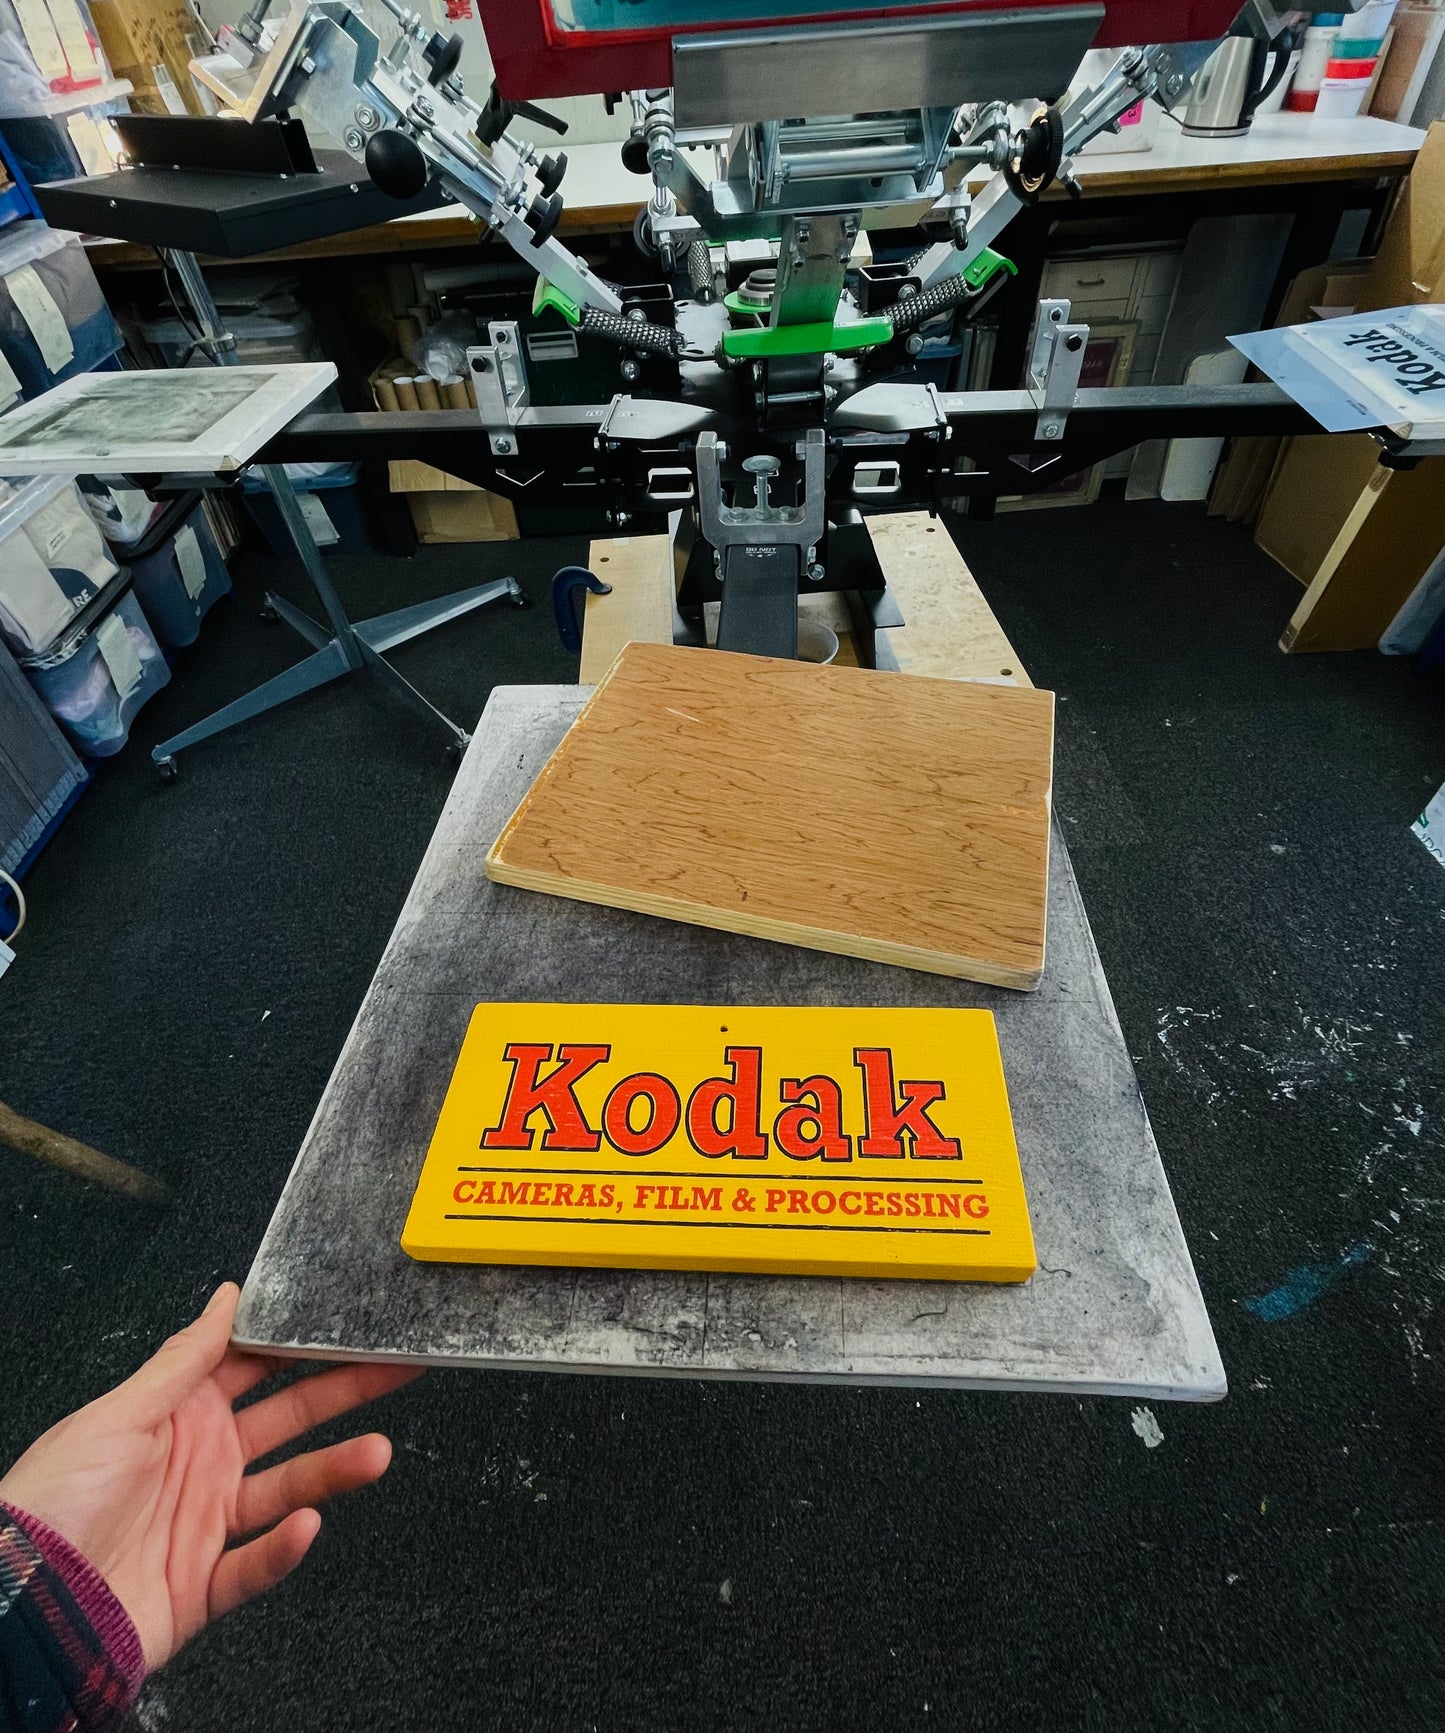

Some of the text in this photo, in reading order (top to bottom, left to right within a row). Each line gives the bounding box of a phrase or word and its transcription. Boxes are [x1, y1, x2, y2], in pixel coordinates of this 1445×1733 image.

[1343, 329, 1445, 395] Kodak
[479, 1042, 964, 1162] Kodak
[452, 1180, 990, 1219] CAMERAS, FILM & PROCESSING
